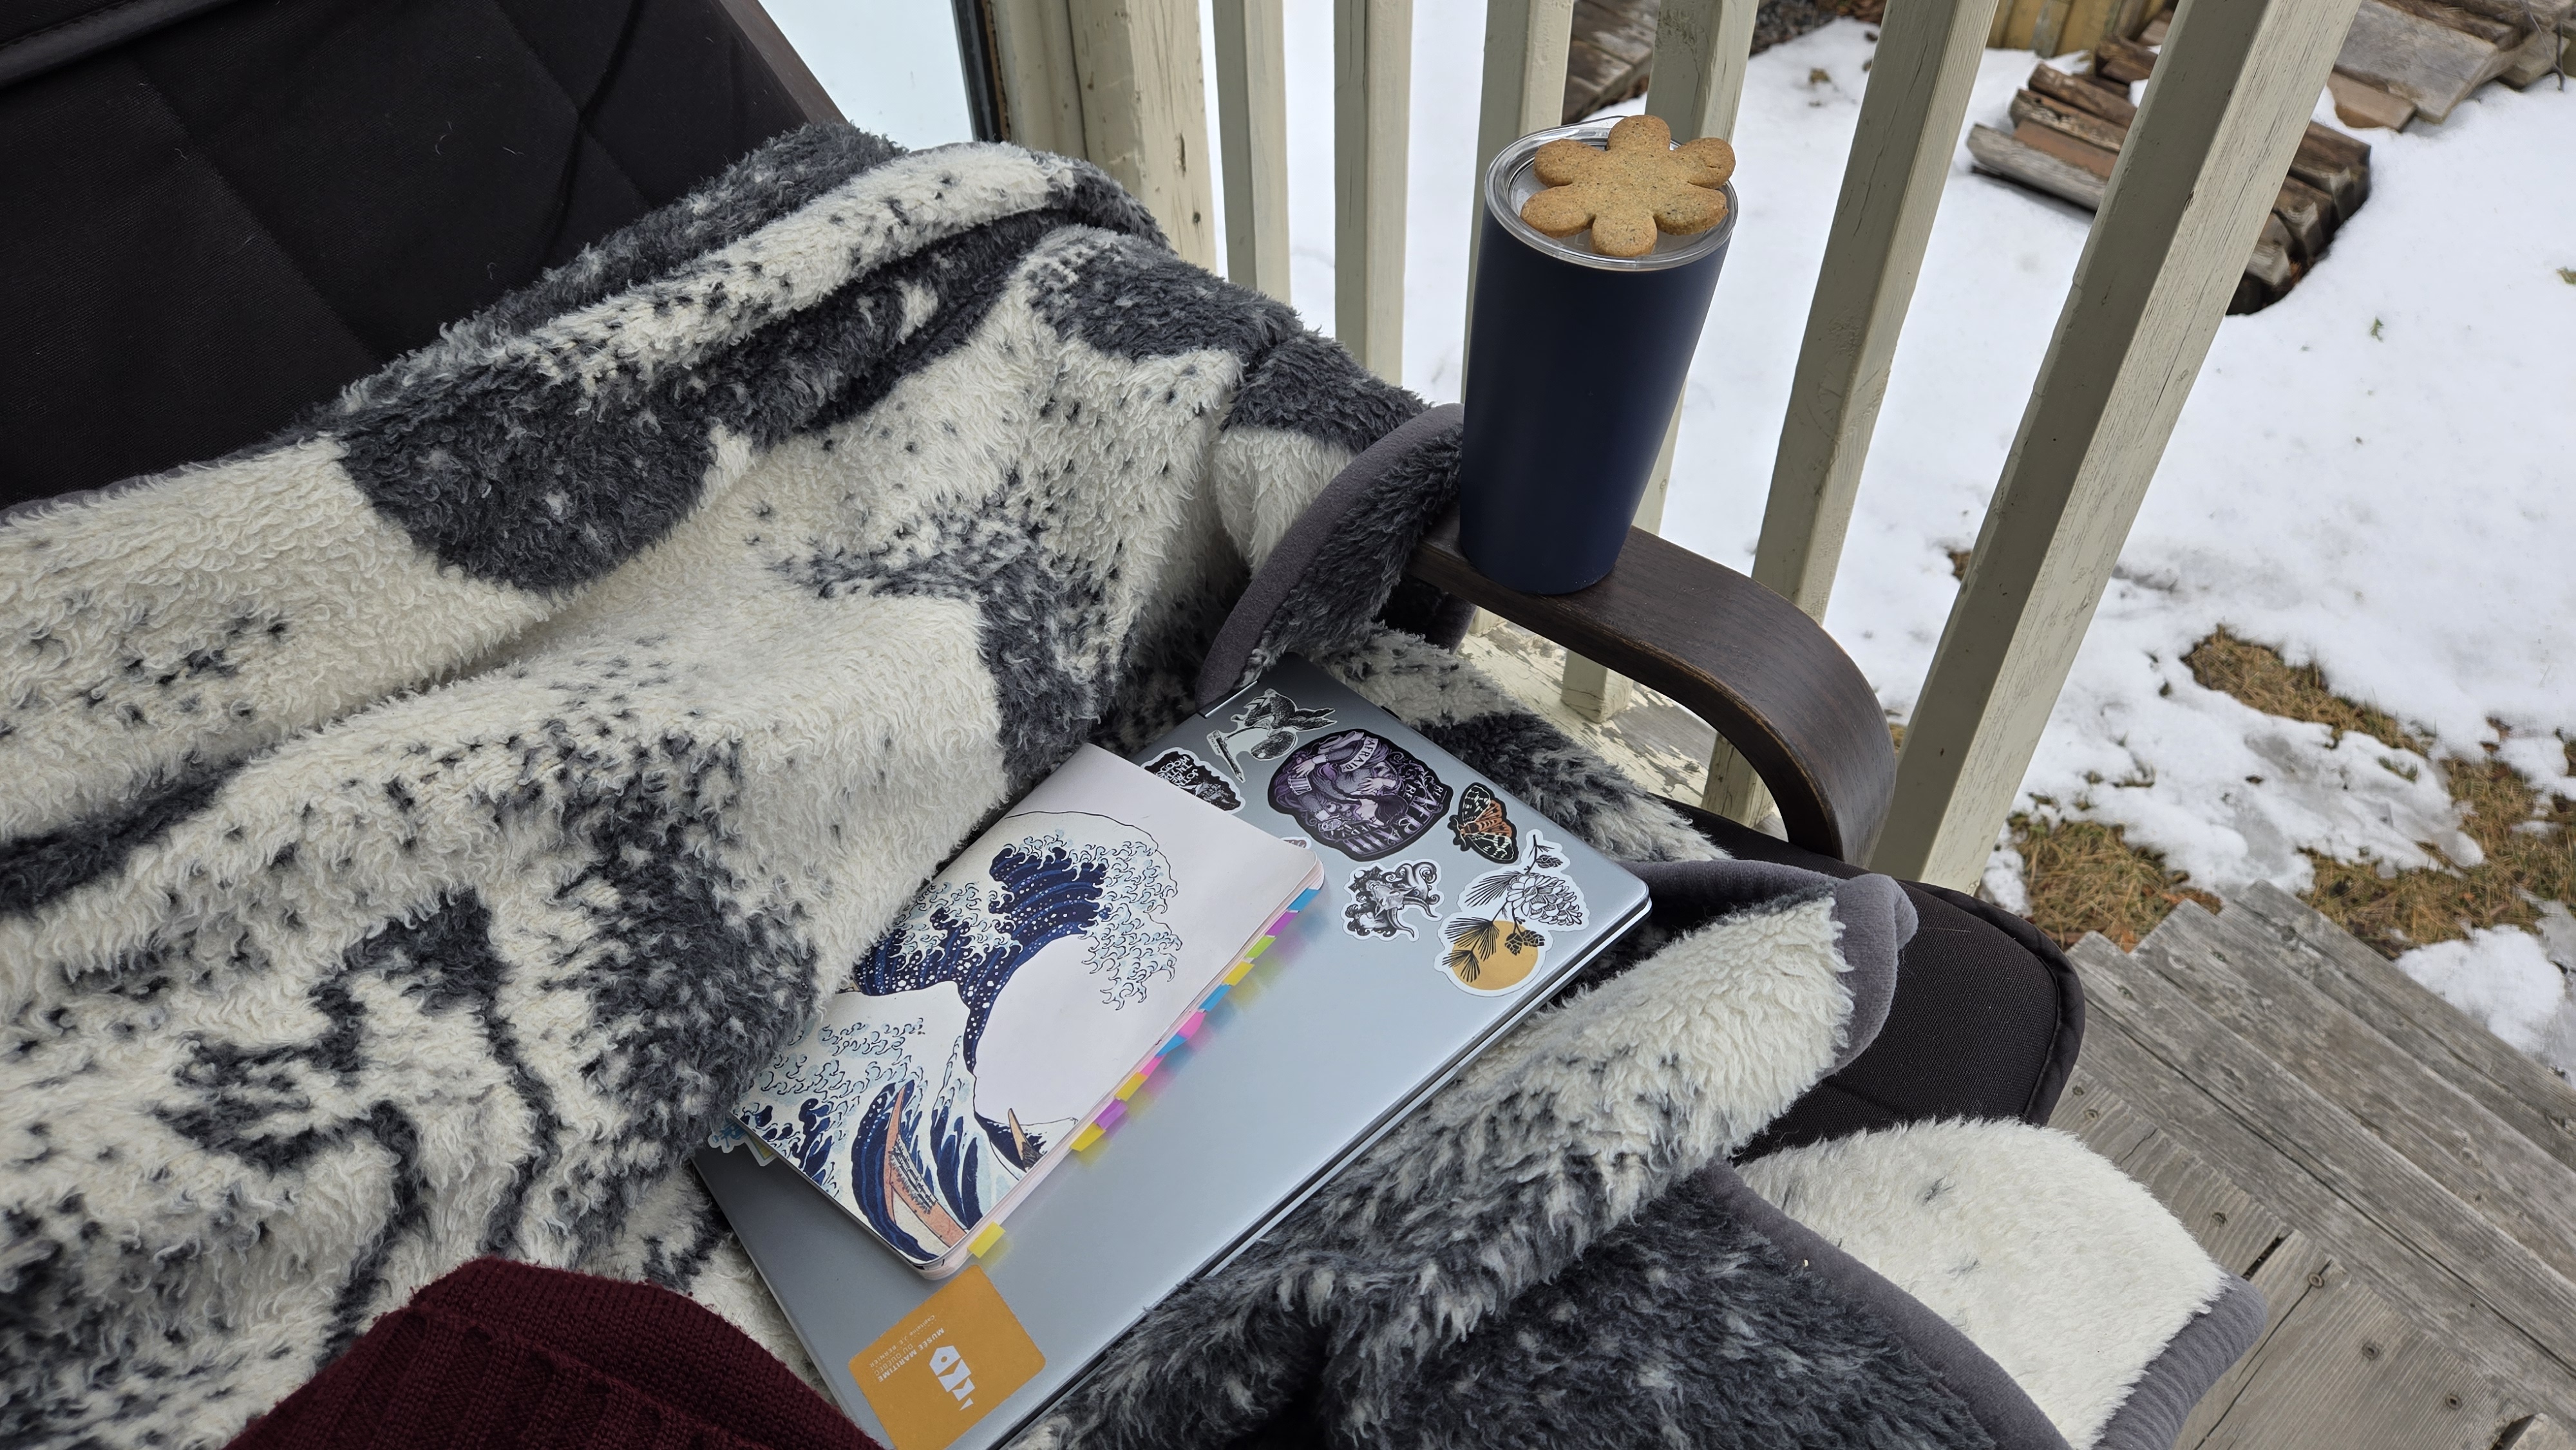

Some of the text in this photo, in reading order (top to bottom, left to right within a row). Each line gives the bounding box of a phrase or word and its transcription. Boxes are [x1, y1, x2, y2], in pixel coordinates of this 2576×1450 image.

[1156, 755, 1190, 779] WOODS
[1345, 740, 1376, 771] AFRAID
[1403, 784, 1417, 800] BE
[1343, 785, 1444, 855] BE AFRAID
[909, 1315, 935, 1336] Capitaine
[869, 1345, 897, 1368] BERNIER
[874, 1343, 913, 1376] DU QUÉBEC
[877, 1328, 945, 1382] MUSÉE MARITIME
